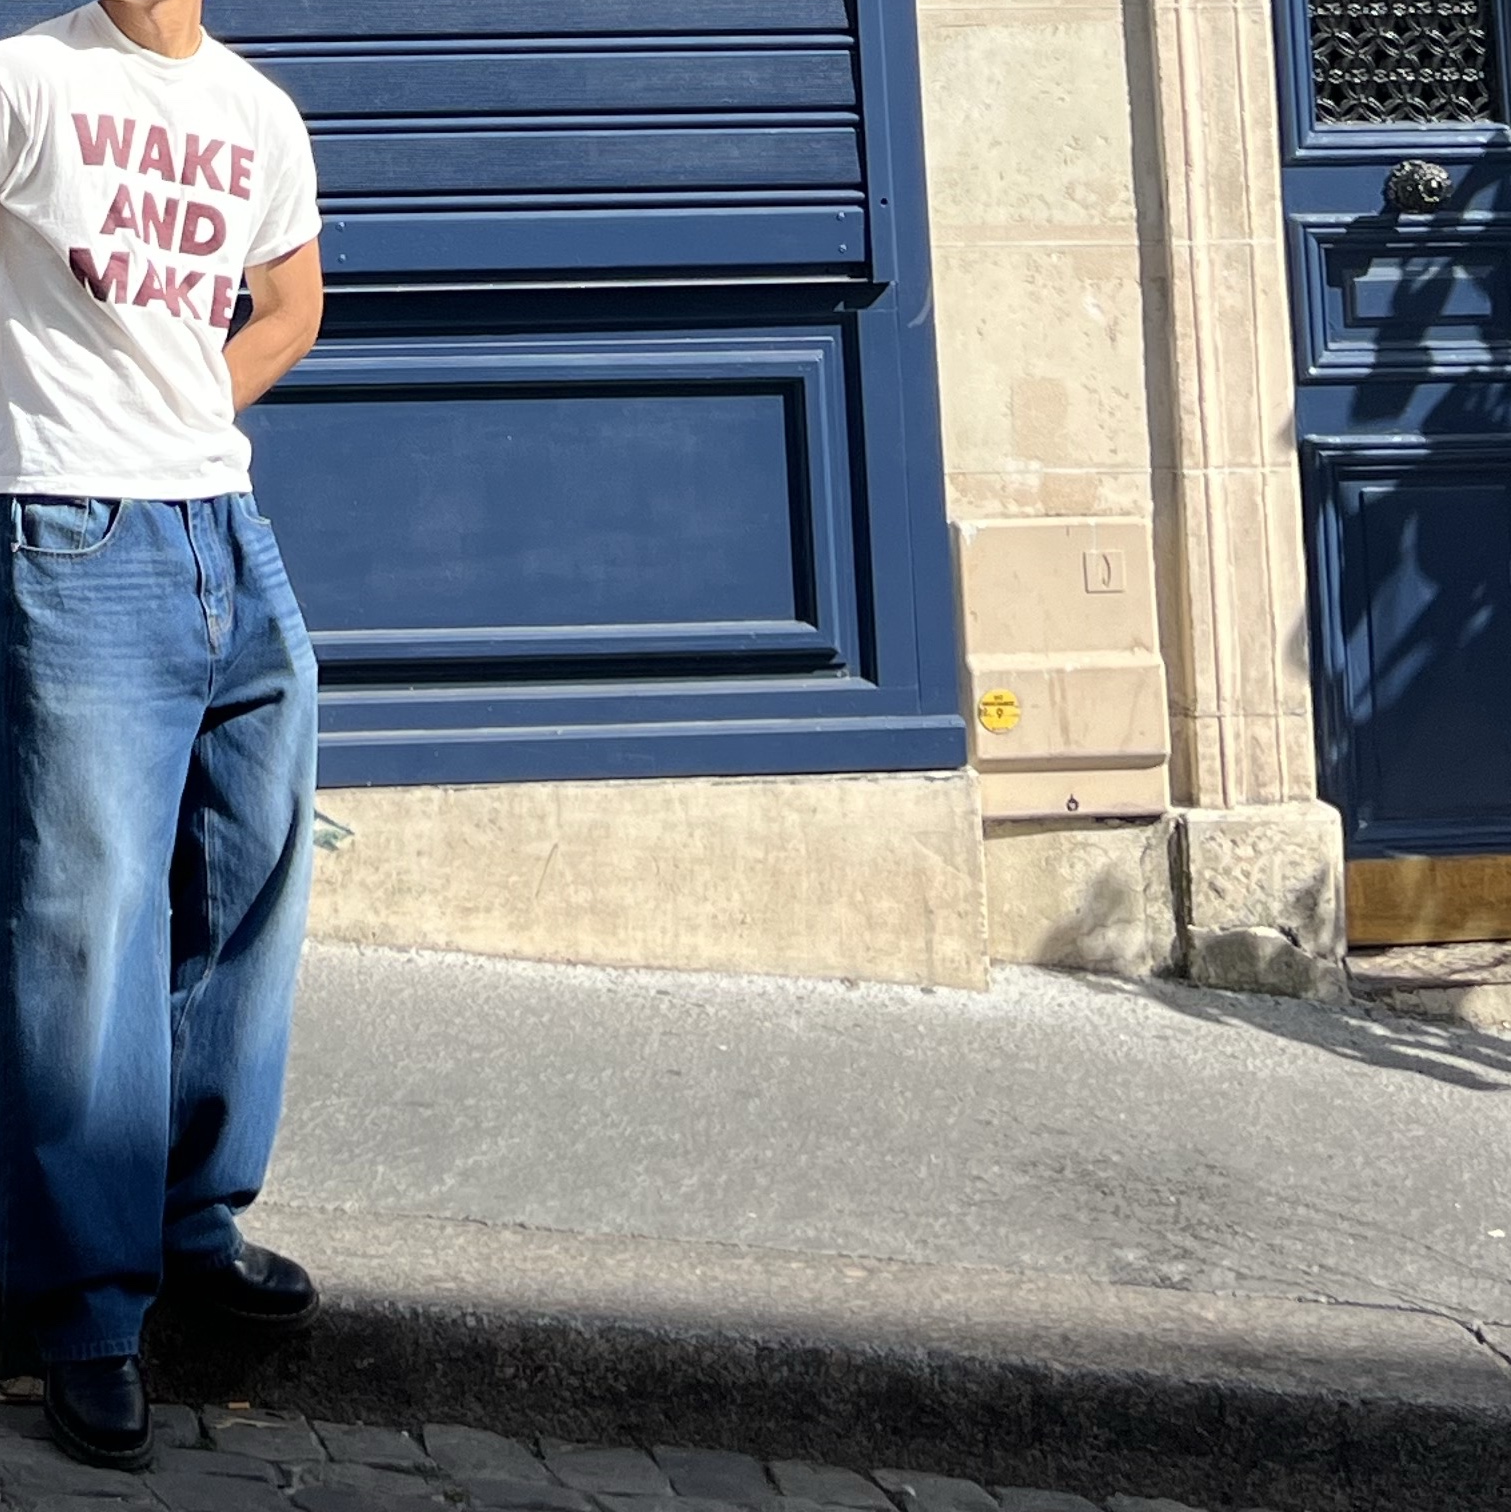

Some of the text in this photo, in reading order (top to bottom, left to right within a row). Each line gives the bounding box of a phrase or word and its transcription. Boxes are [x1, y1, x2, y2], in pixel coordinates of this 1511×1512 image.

[71, 113, 254, 201] WAKE
[99, 183, 226, 256] AND
[69, 246, 233, 328] MAKE
